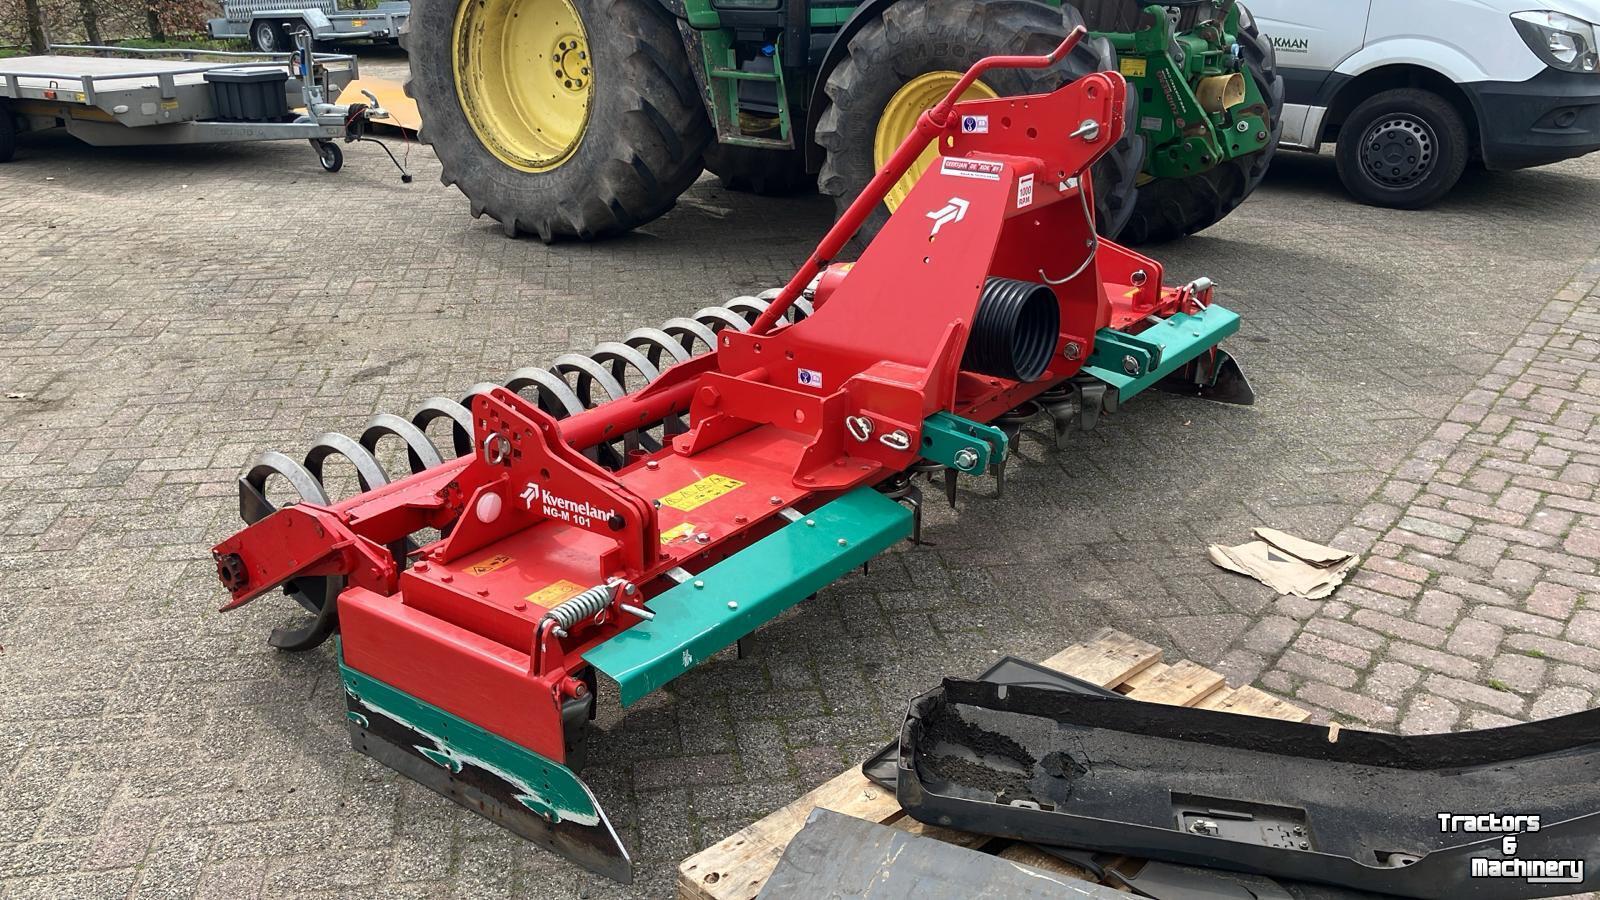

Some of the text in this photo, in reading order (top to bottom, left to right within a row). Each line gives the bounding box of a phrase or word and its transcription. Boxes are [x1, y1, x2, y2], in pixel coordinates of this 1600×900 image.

[1020, 185, 1031, 197] 1000
[541, 489, 615, 522] Kverneland
[542, 505, 590, 527] NG-M 101
